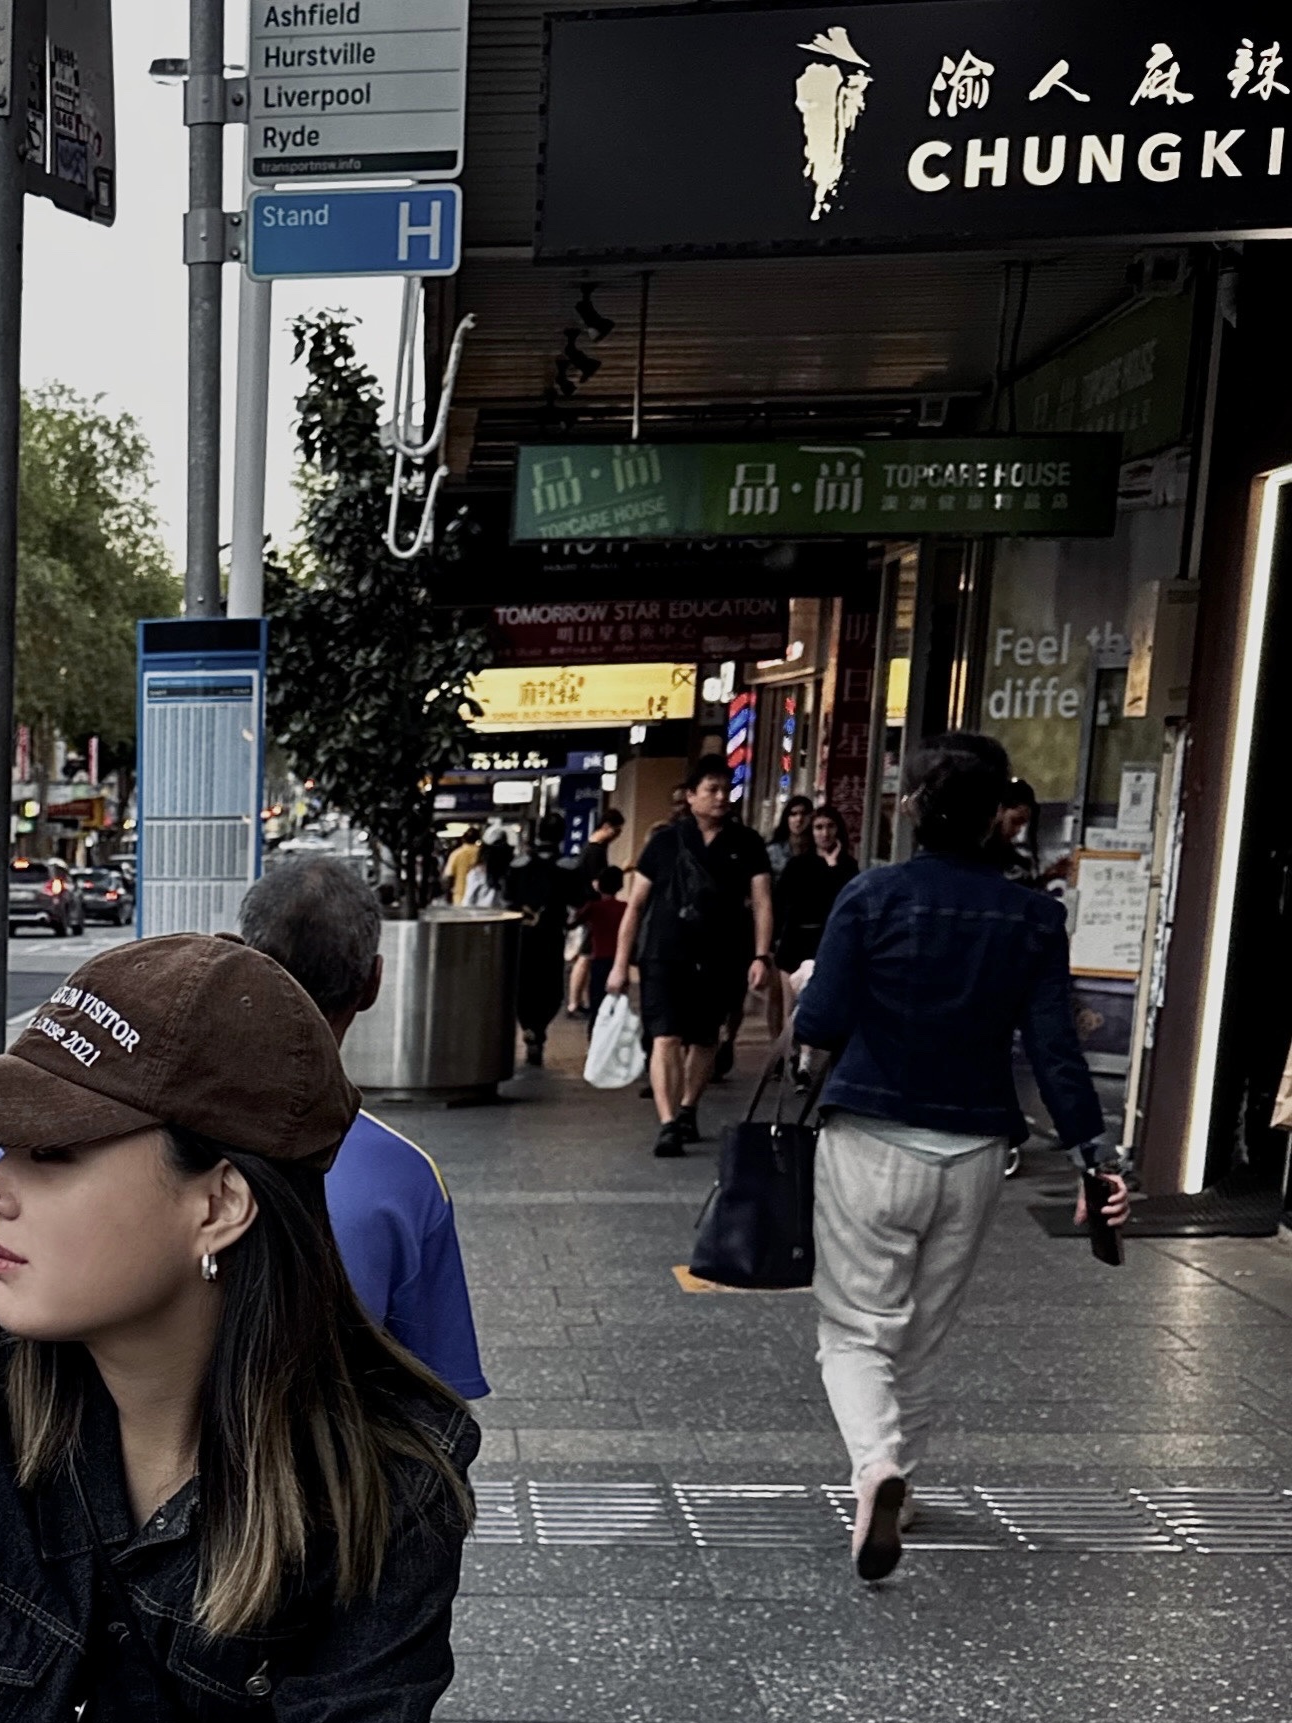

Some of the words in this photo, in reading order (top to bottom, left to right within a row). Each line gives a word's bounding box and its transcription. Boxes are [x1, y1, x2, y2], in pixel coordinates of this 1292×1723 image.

[263, 2, 361, 28] Ashfield
[264, 42, 376, 68] Hurstville
[263, 82, 371, 111] Liverpool
[262, 125, 320, 153] Ryde
[261, 158, 362, 174] transportnsw.info
[908, 126, 1285, 193] CHUNGKI
[262, 204, 329, 228] Stand
[397, 200, 441, 261] H
[882, 461, 989, 489] TOPCARE
[992, 461, 1072, 488] HOUSE
[613, 496, 670, 525] HOUSE
[494, 601, 609, 626] TOMORROW
[613, 602, 661, 621] STAR
[668, 599, 778, 619] EDUCATION
[994, 622, 1072, 667] Feel
[78, 992, 141, 1053] VISITOR
[60, 1030, 102, 1068] 2021
